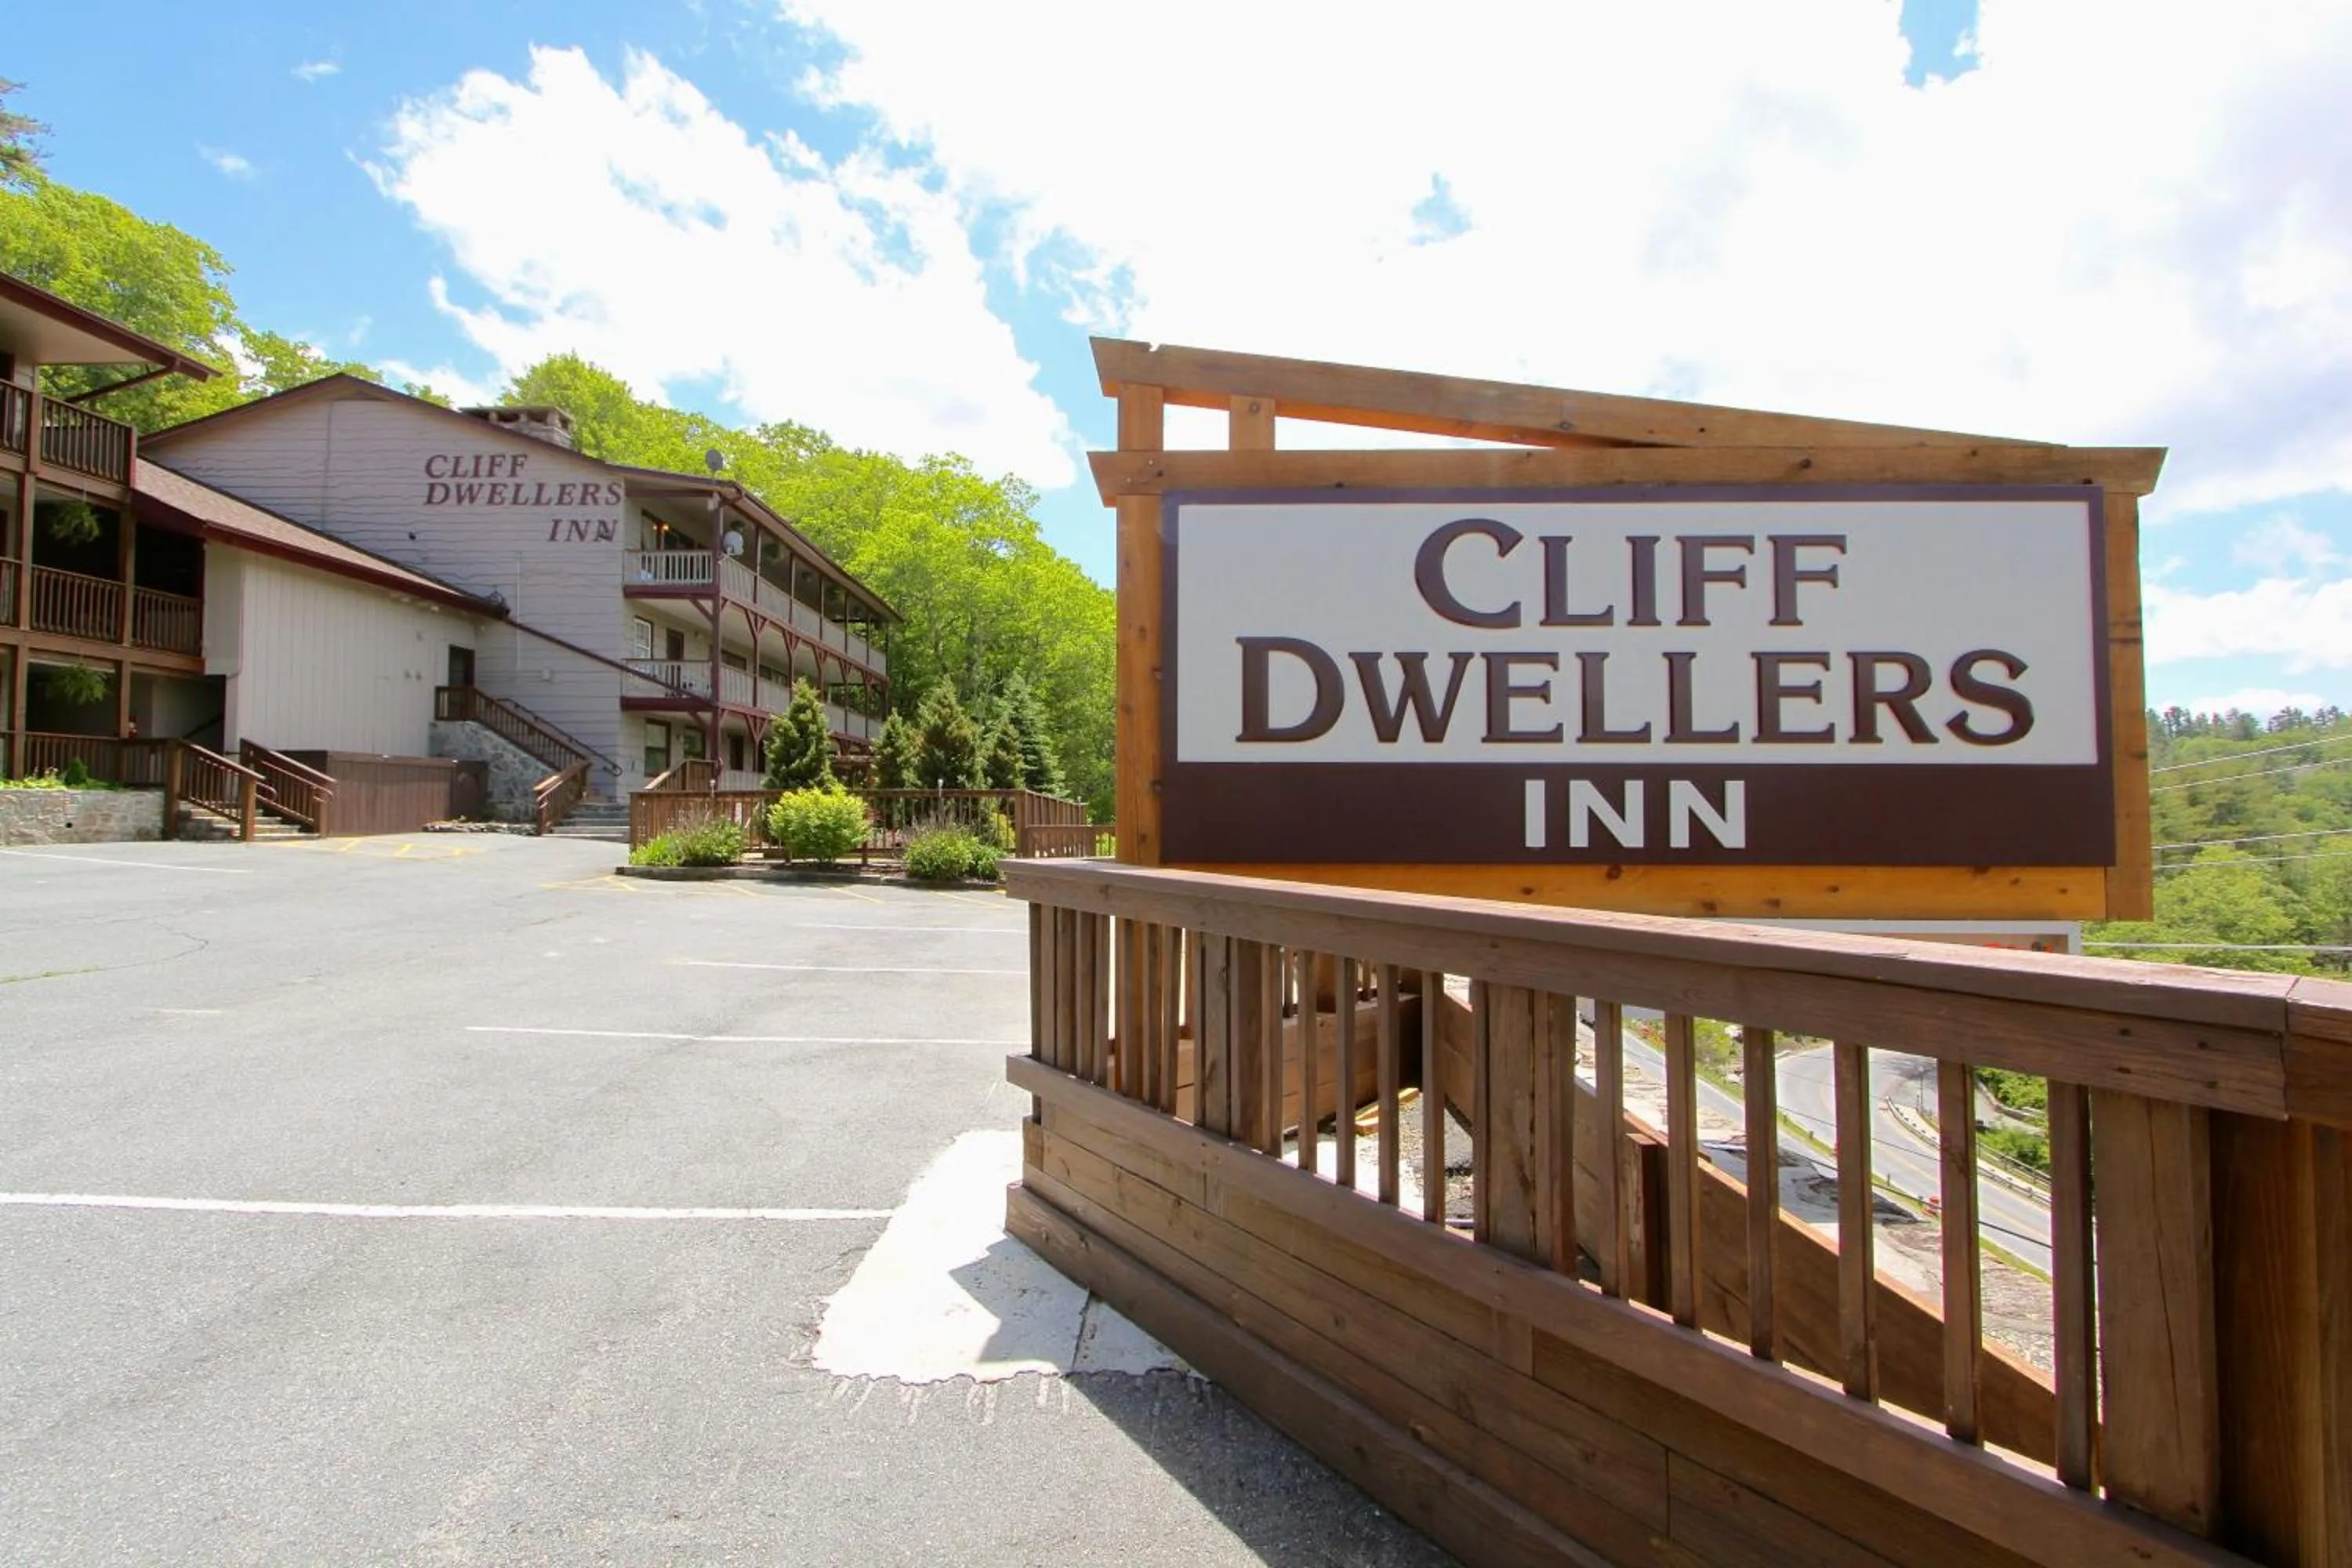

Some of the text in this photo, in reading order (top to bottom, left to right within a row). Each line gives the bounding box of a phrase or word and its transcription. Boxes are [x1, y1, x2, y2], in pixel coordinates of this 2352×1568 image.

[424, 454, 528, 478] CLIFF
[423, 482, 622, 506] DWELLERS
[548, 518, 618, 543] INN
[1414, 518, 1848, 629] CLIFF
[1235, 636, 2036, 746] DWELLERS
[1525, 779, 1746, 848] INN
